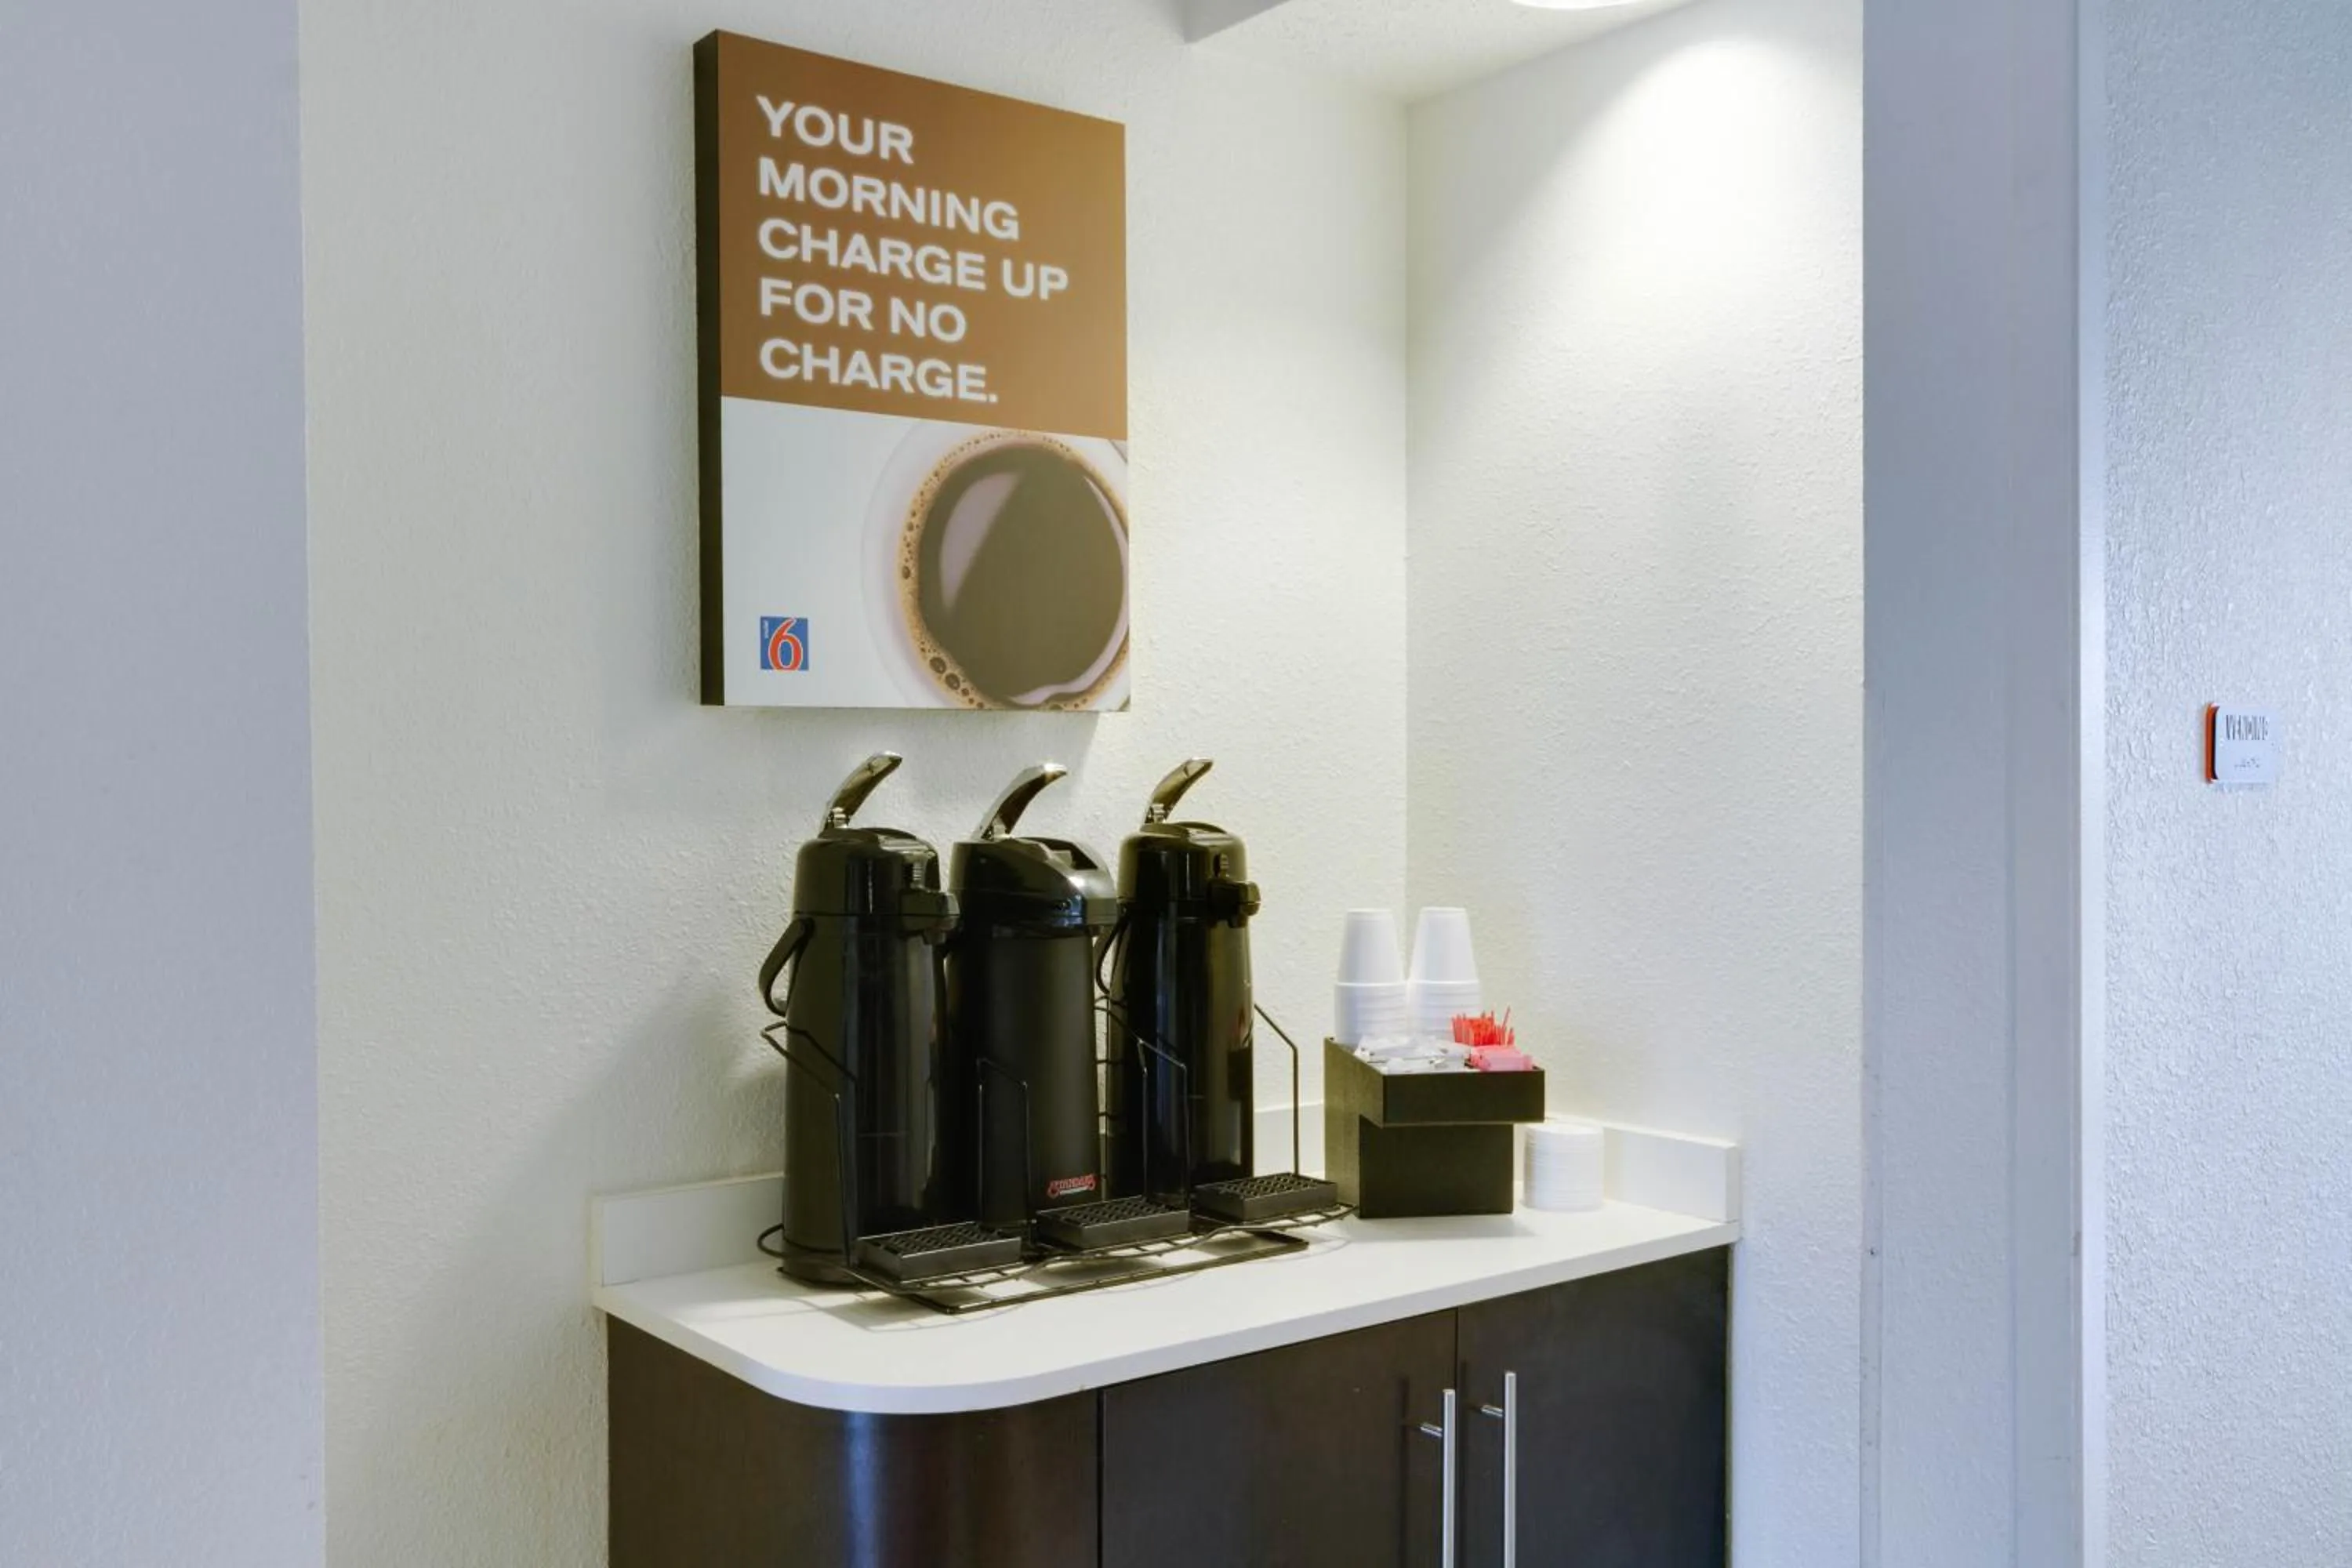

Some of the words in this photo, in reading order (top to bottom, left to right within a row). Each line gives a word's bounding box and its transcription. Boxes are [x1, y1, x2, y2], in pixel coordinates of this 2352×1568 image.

[756, 95, 914, 165] YOUR
[759, 156, 1020, 241] MORNING
[758, 218, 987, 292] CHARGE
[1001, 258, 1069, 301] UP
[760, 277, 873, 331] FOR
[889, 296, 967, 343] NO
[759, 337, 999, 405] CHARGE.
[768, 616, 803, 672] 6
